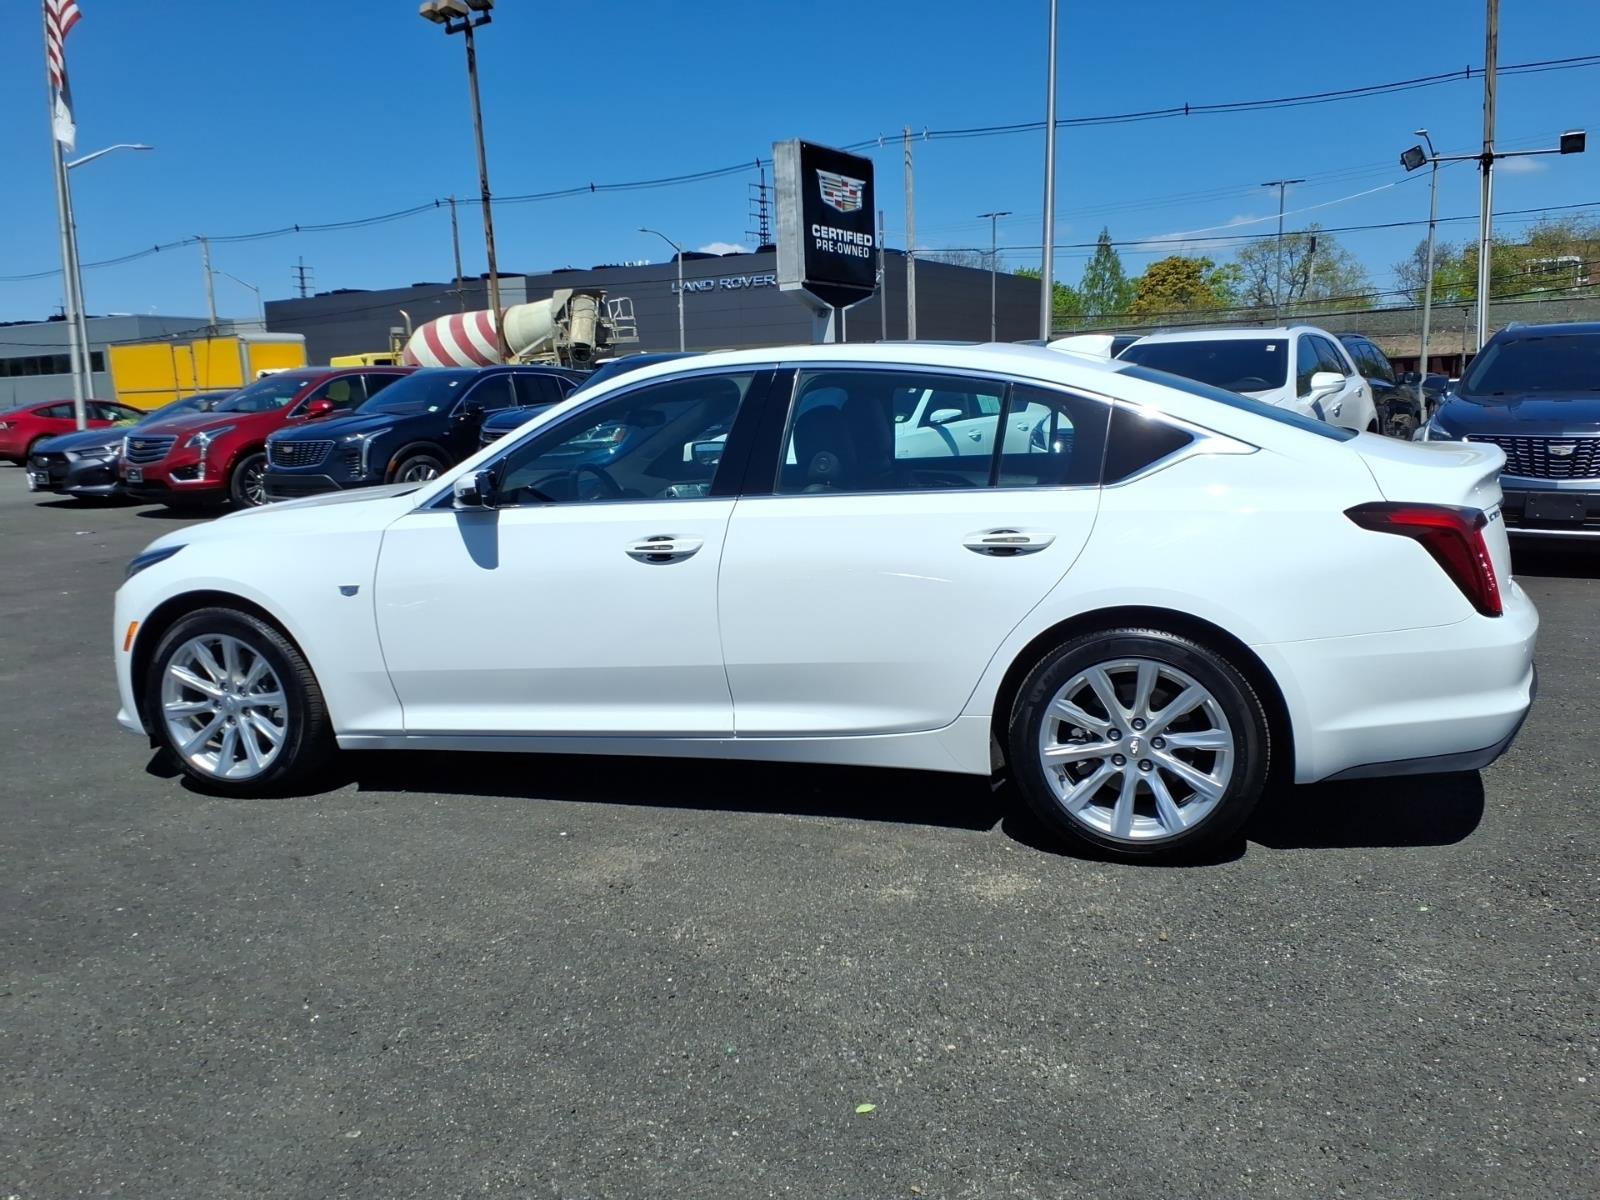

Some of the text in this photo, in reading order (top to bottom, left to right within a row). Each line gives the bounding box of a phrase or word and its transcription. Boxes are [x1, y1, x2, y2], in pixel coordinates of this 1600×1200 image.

[811, 224, 873, 247] CERTIFIED
[816, 238, 870, 258] PRE-OWNED
[671, 274, 777, 294] LAND ROVER
